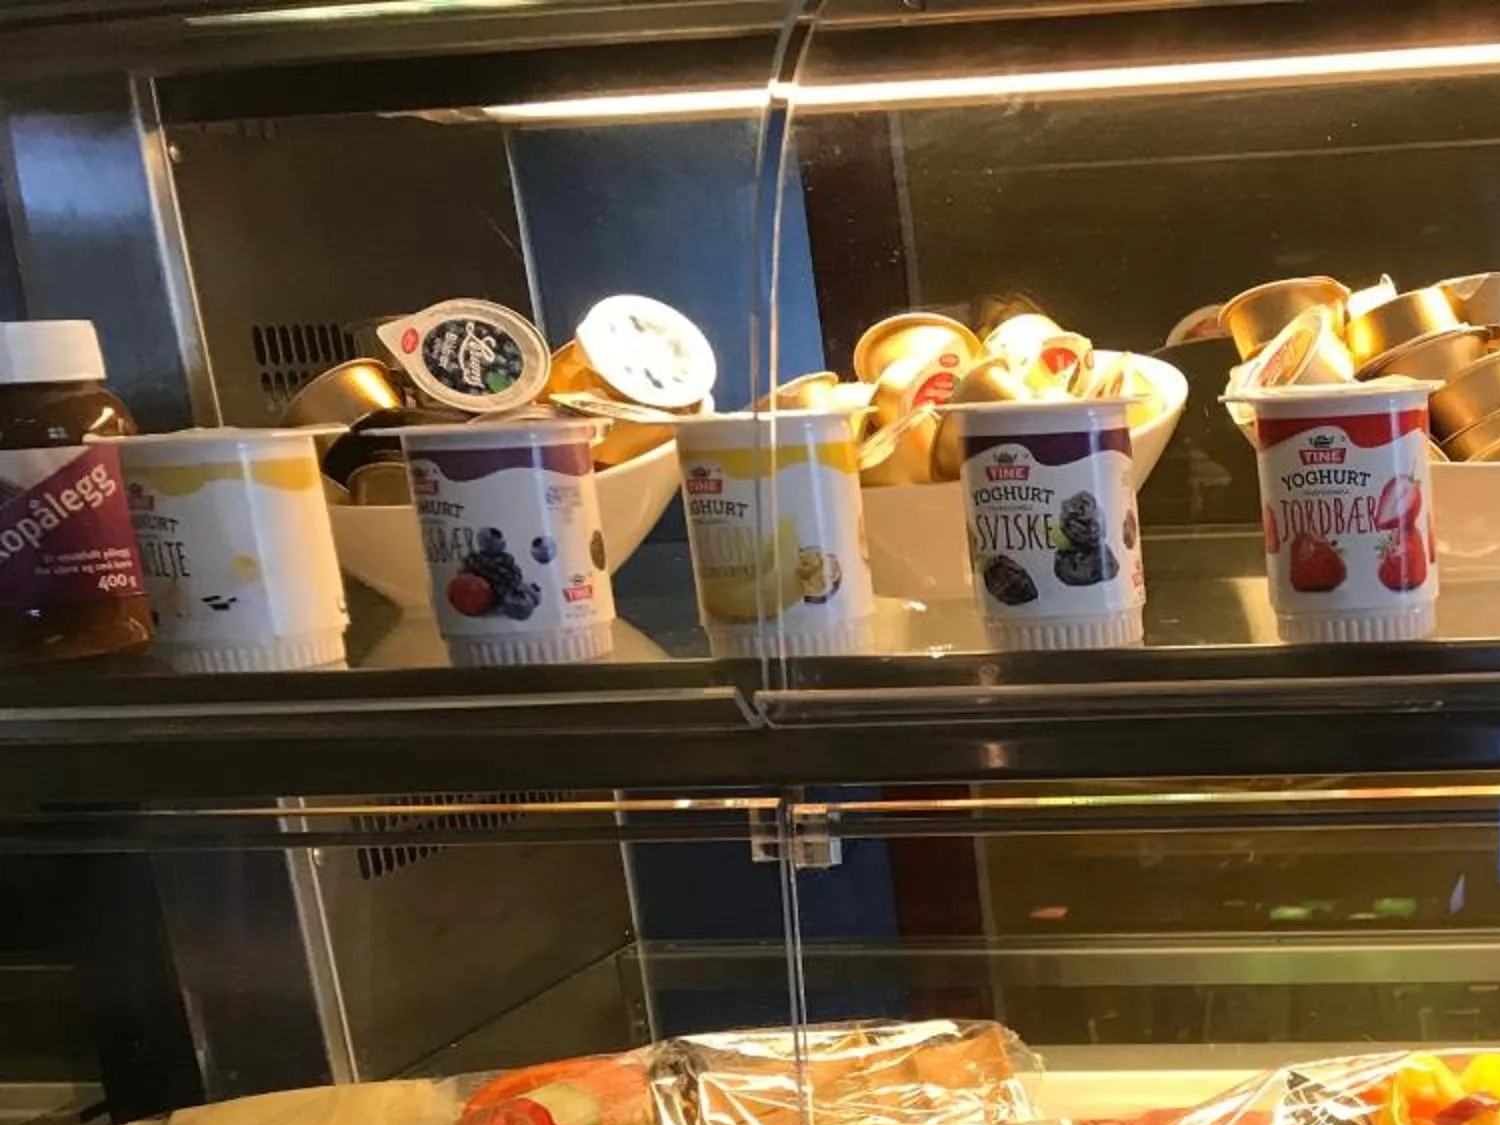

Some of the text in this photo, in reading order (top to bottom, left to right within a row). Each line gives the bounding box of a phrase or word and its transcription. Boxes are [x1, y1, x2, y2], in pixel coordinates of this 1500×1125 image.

[1303, 452, 1344, 465] TINE
[992, 466, 1027, 480] TINE
[1281, 469, 1372, 491] YOGHURT
[973, 486, 1055, 506] YOGHURT
[0, 463, 117, 558] opålegg
[690, 500, 749, 518] GHURT
[1280, 498, 1380, 543] JORDBÆR
[975, 512, 1057, 551] SVISKE
